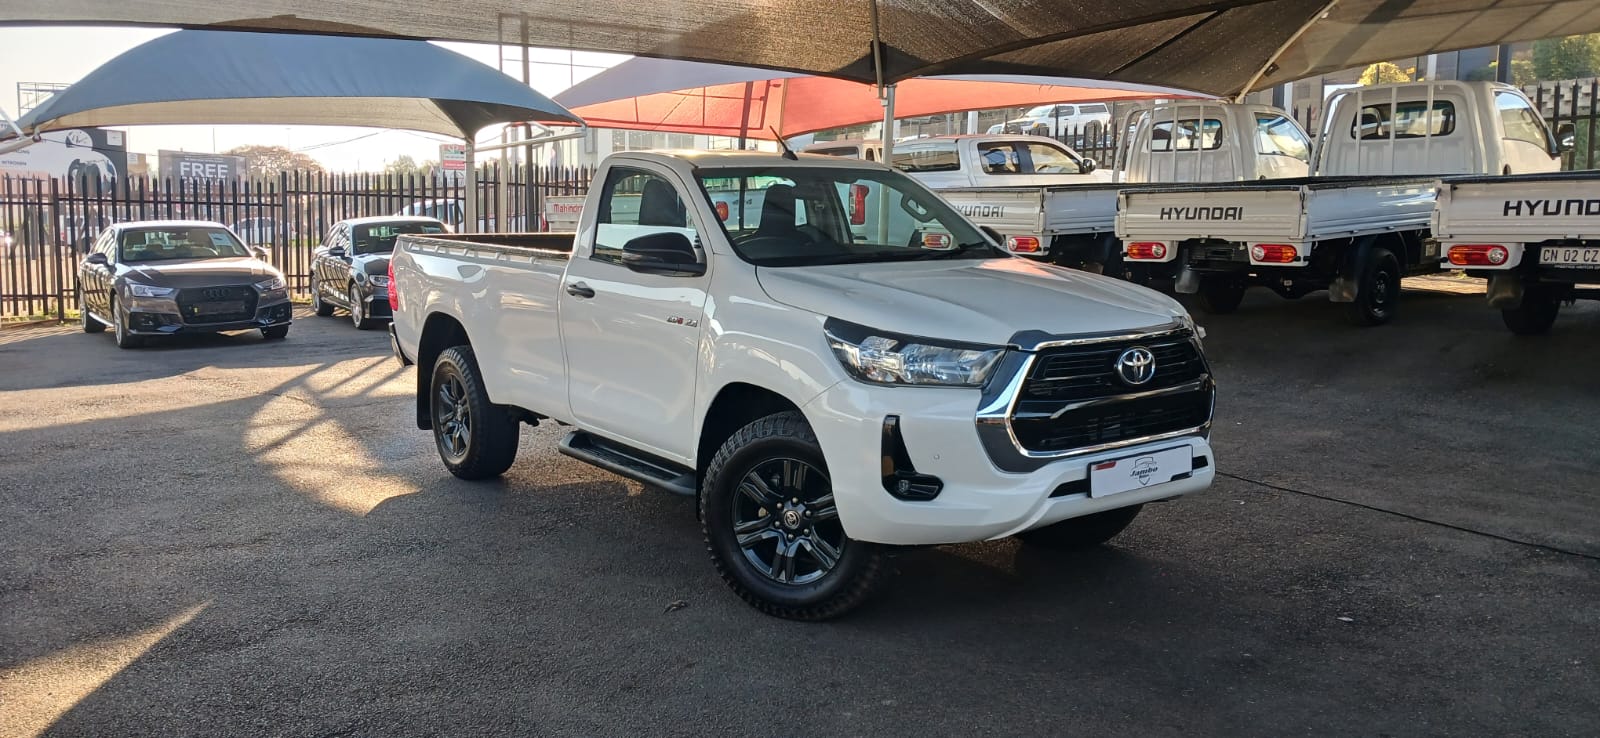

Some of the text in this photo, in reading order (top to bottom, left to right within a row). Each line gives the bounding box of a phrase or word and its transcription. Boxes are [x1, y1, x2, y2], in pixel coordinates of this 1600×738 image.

[180, 161, 229, 178] FREE
[953, 205, 1004, 217] YUNDAI
[1160, 206, 1243, 220] HYUNDAI
[1543, 249, 1599, 262] CN 02 CZ
